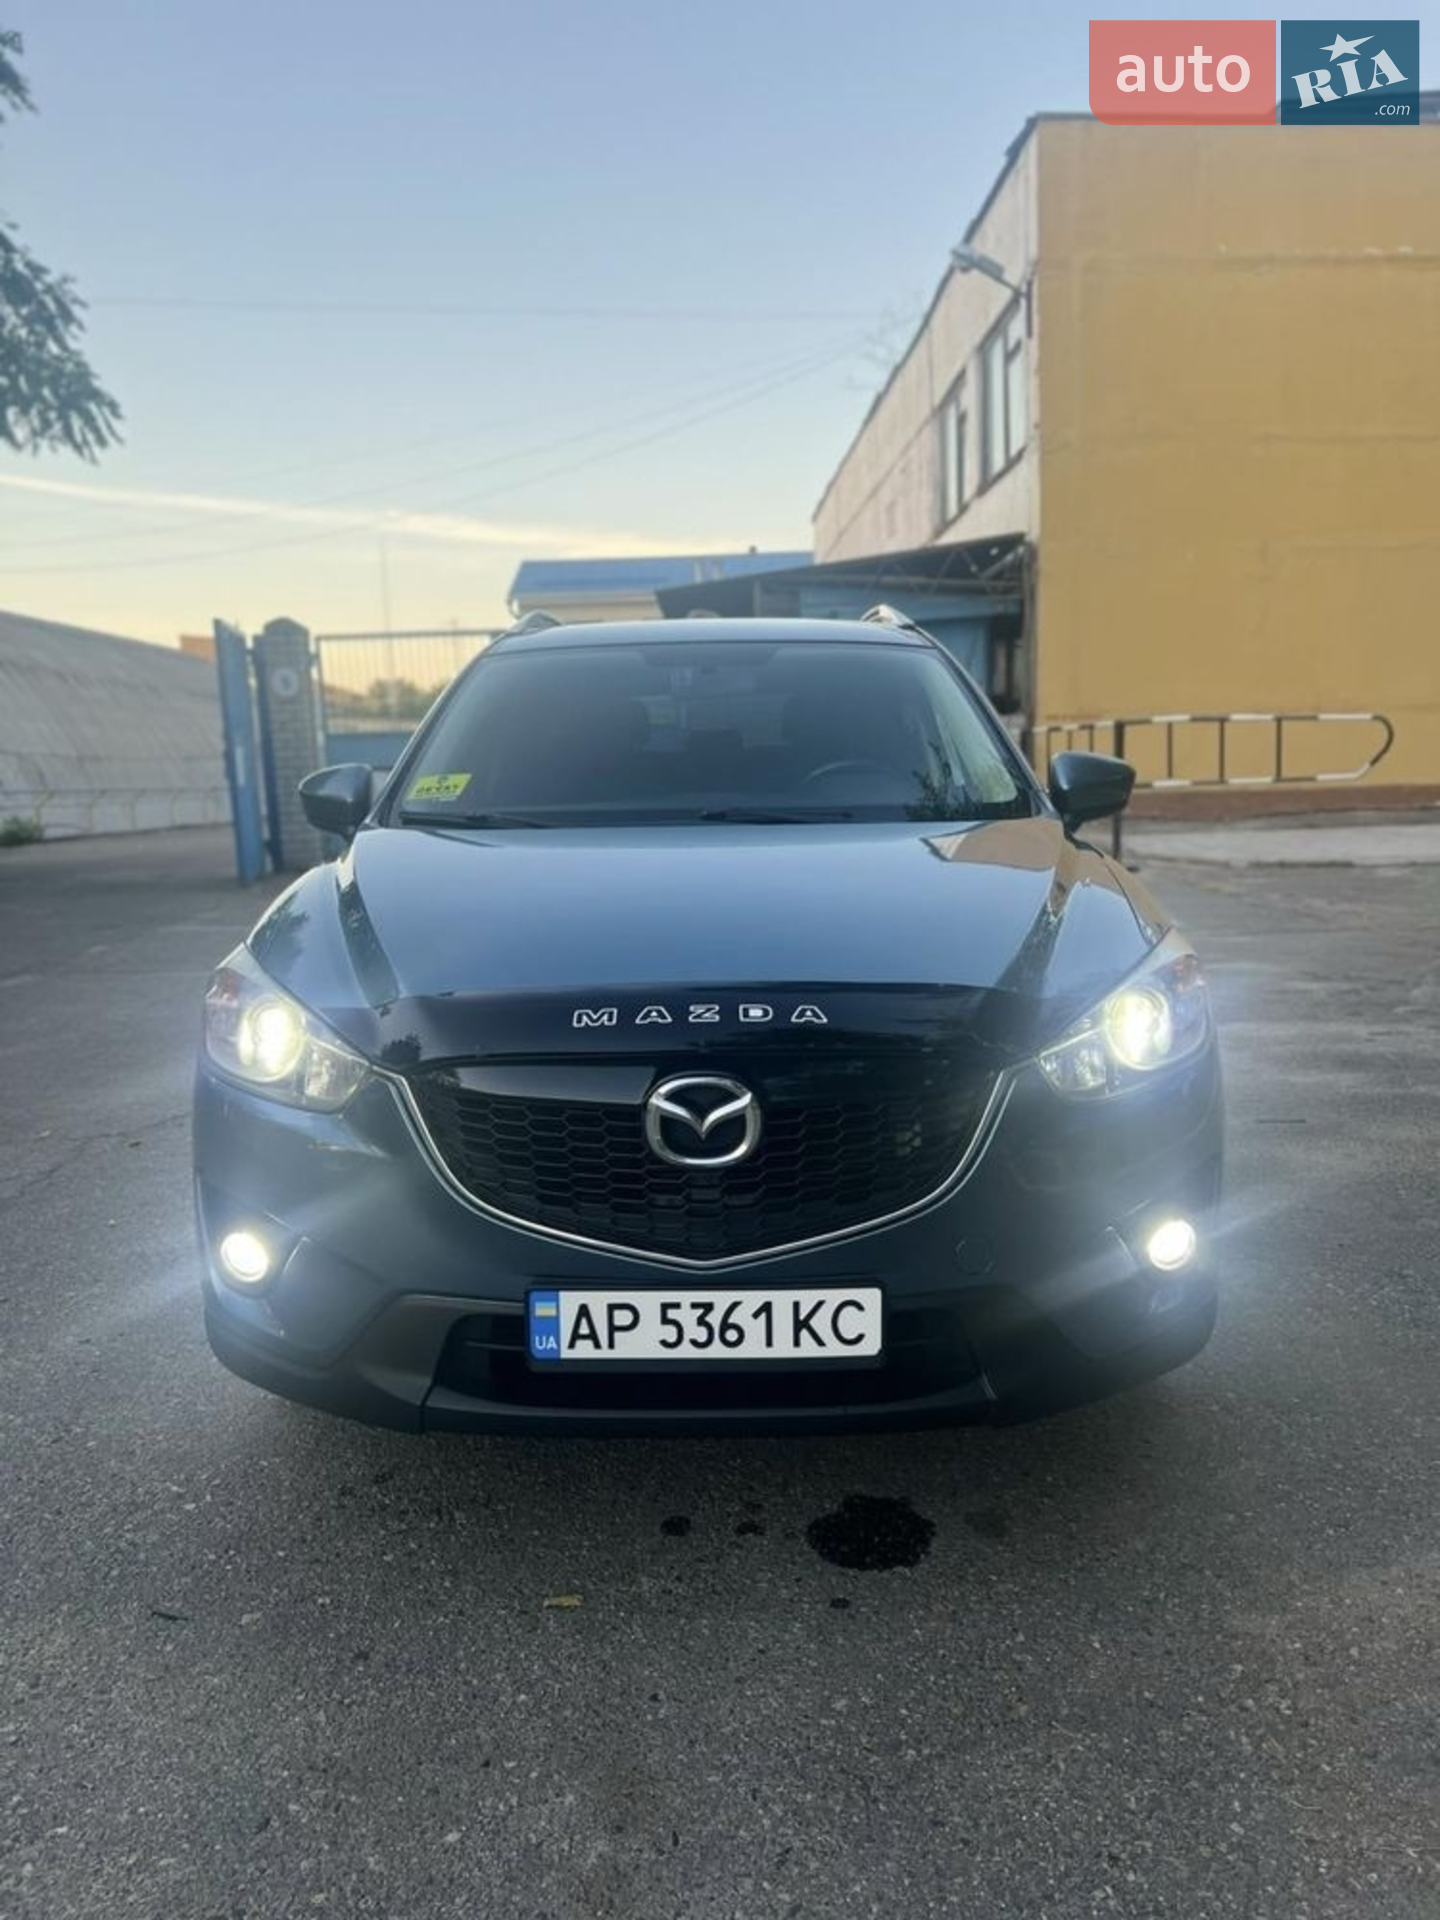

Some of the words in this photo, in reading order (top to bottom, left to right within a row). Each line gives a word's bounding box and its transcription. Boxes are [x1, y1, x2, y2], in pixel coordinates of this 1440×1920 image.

[572, 1004, 828, 1027] MAZDA
[567, 1302, 641, 1350] AP
[658, 1300, 773, 1349] 5361
[792, 1299, 866, 1348] KC
[535, 1335, 558, 1350] UA
